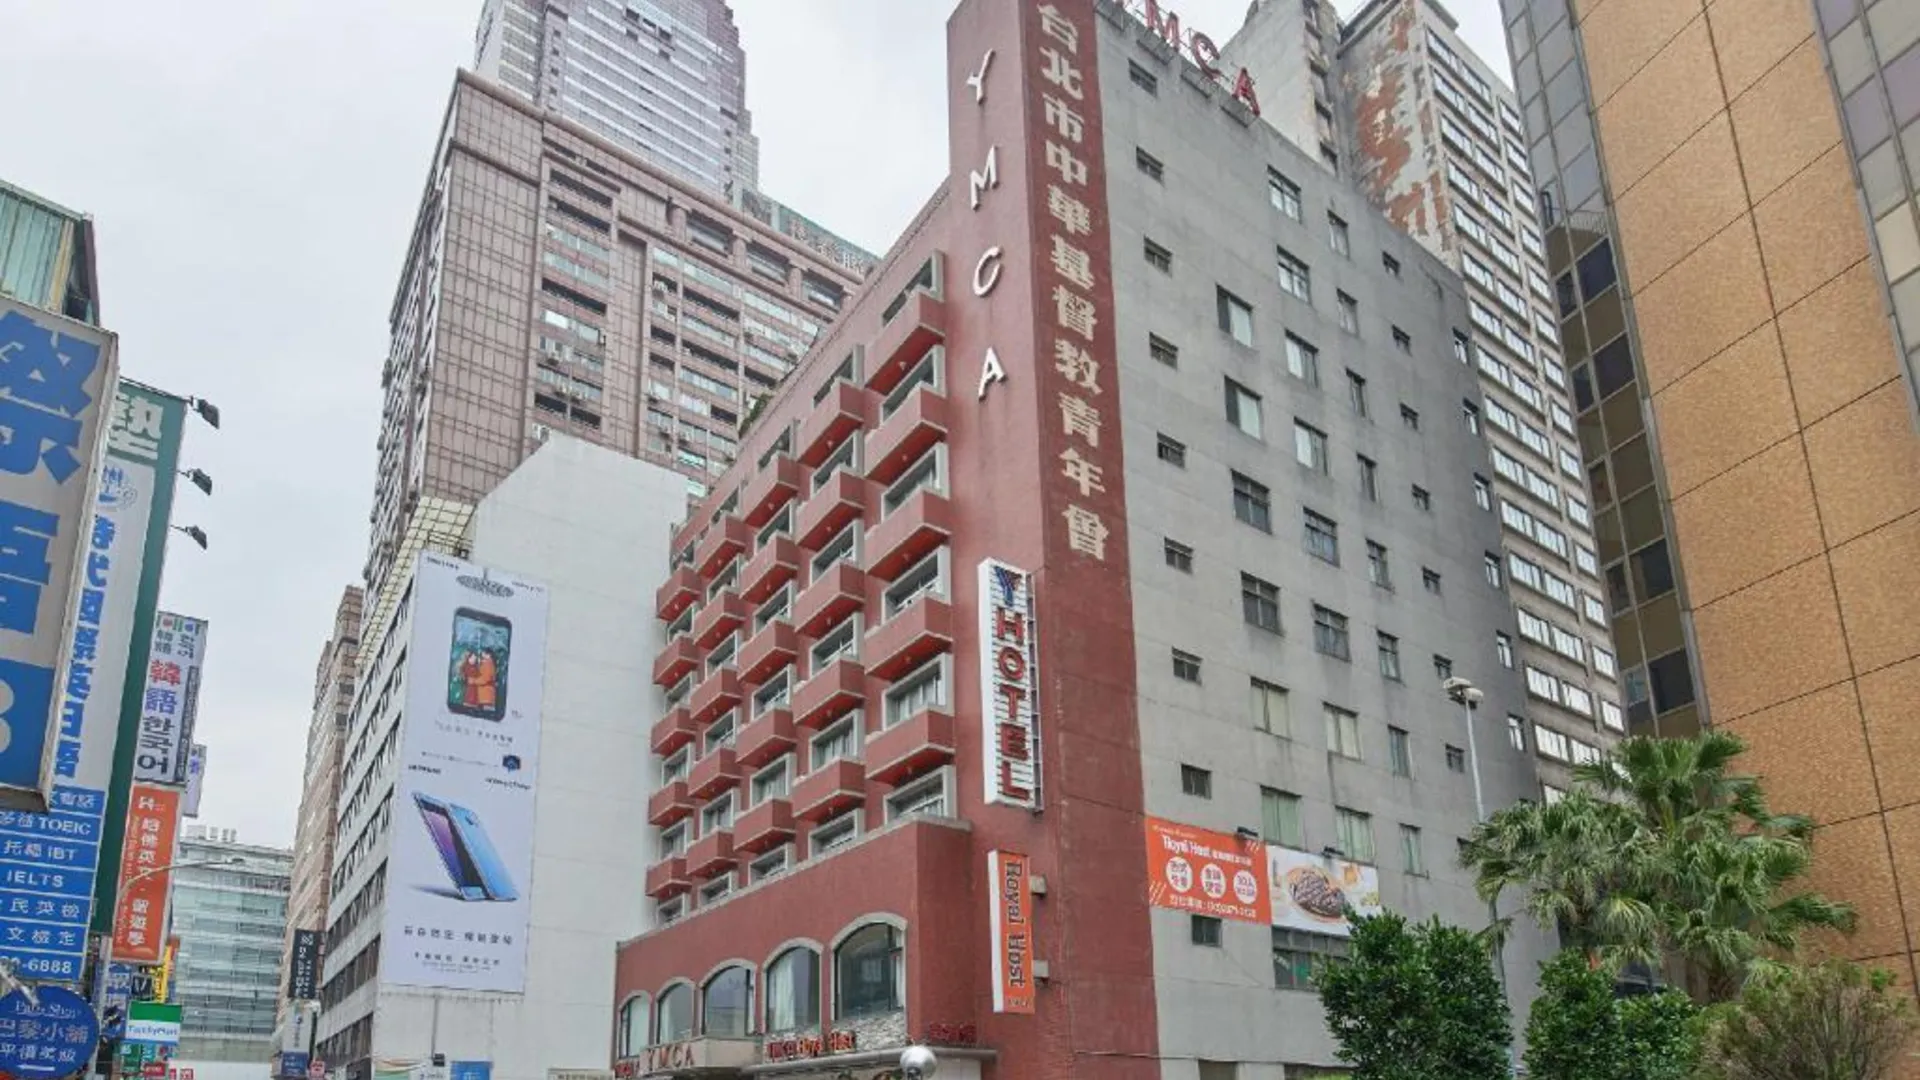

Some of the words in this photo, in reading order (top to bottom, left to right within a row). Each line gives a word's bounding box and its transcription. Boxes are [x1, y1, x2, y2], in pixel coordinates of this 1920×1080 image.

[1116, 0, 1260, 117] MCA
[966, 47, 1007, 402] YMCA
[1037, 3, 1109, 561] 台北市中華基督教青年會
[997, 607, 1030, 801] HOTEL
[38, 816, 92, 835] TOEIC
[7, 869, 64, 888] IELTS
[0, 955, 73, 975] -6888
[1008, 933, 1027, 988] Host
